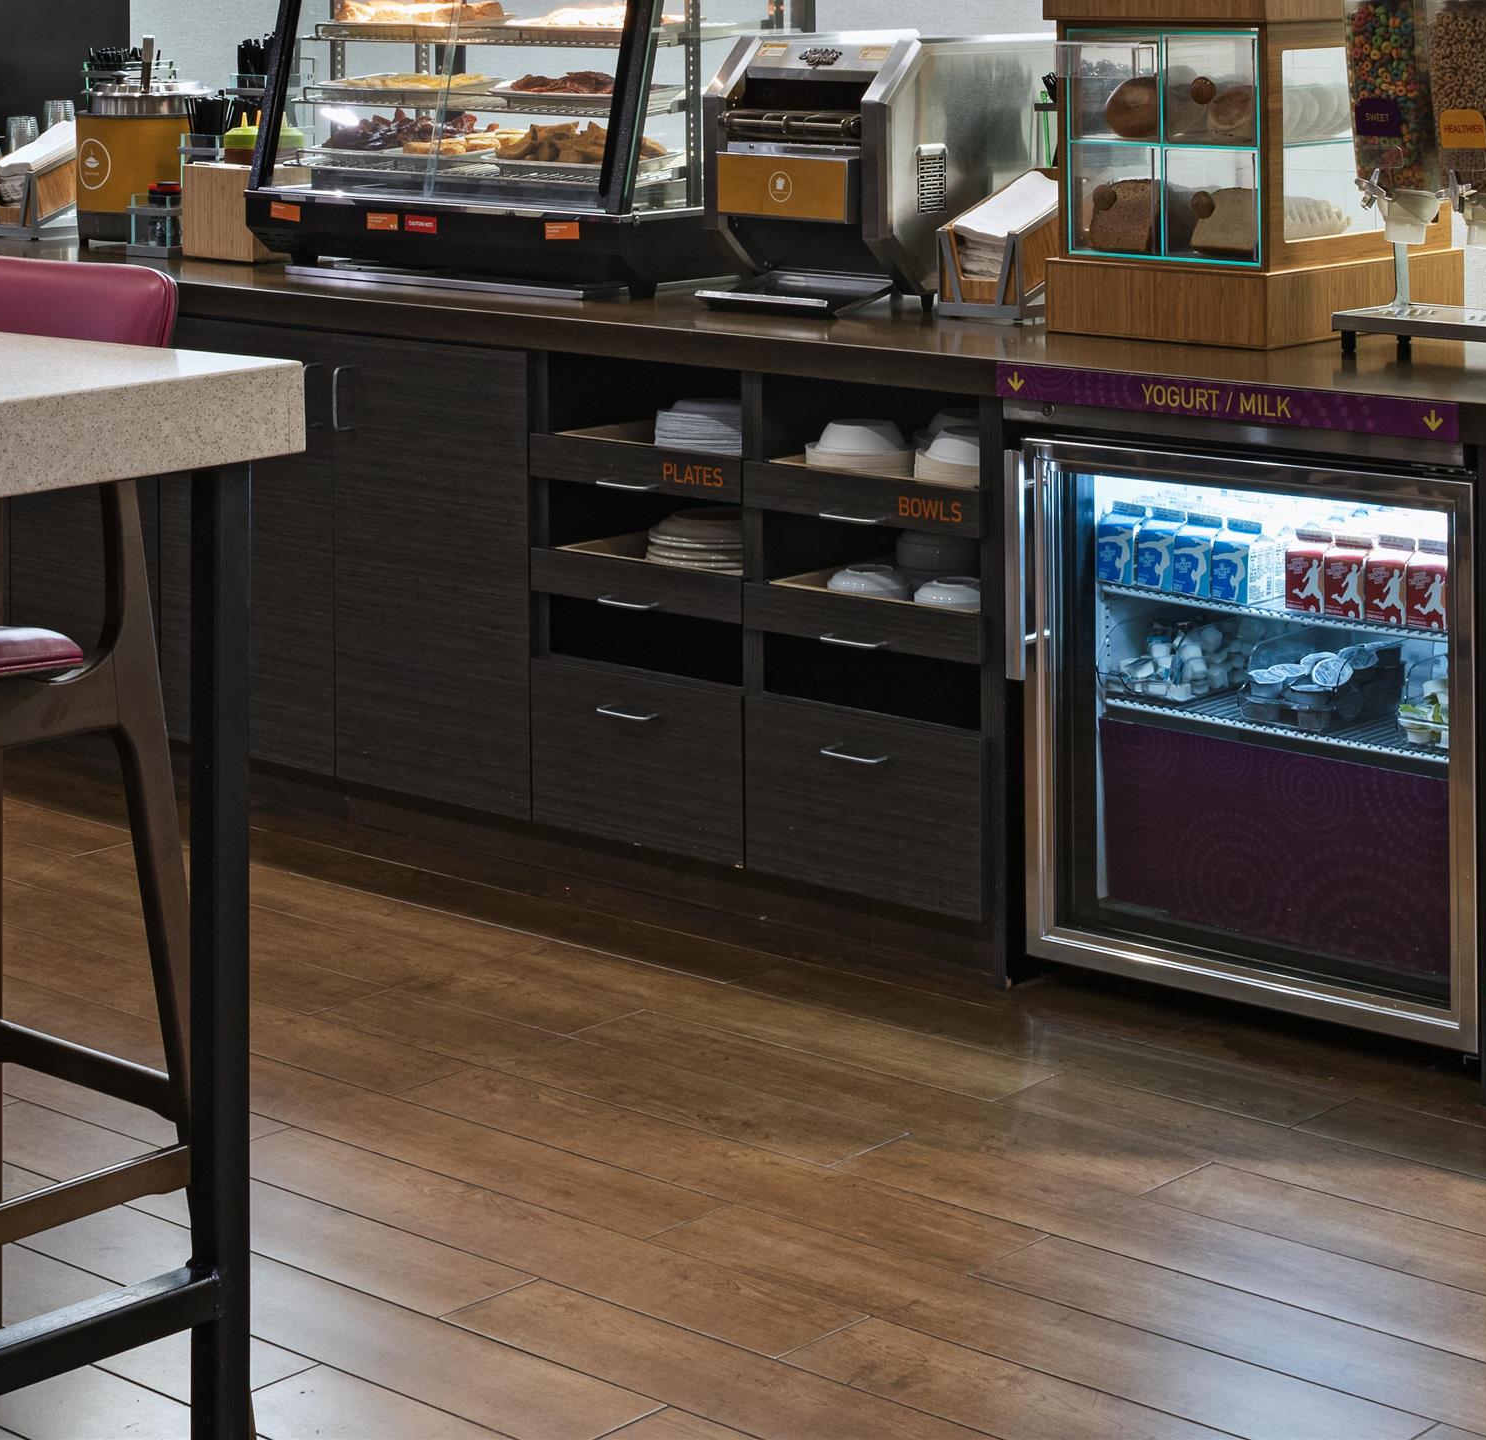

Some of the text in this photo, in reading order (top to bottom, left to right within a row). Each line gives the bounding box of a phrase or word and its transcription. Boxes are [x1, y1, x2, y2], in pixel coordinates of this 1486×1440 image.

[1365, 112, 1390, 122] SWEET
[1443, 124, 1484, 133] HEALTHIER
[1142, 383, 1292, 419] YOGURT / MILK
[662, 463, 724, 488] PLATES
[898, 496, 963, 523] BOWLS
